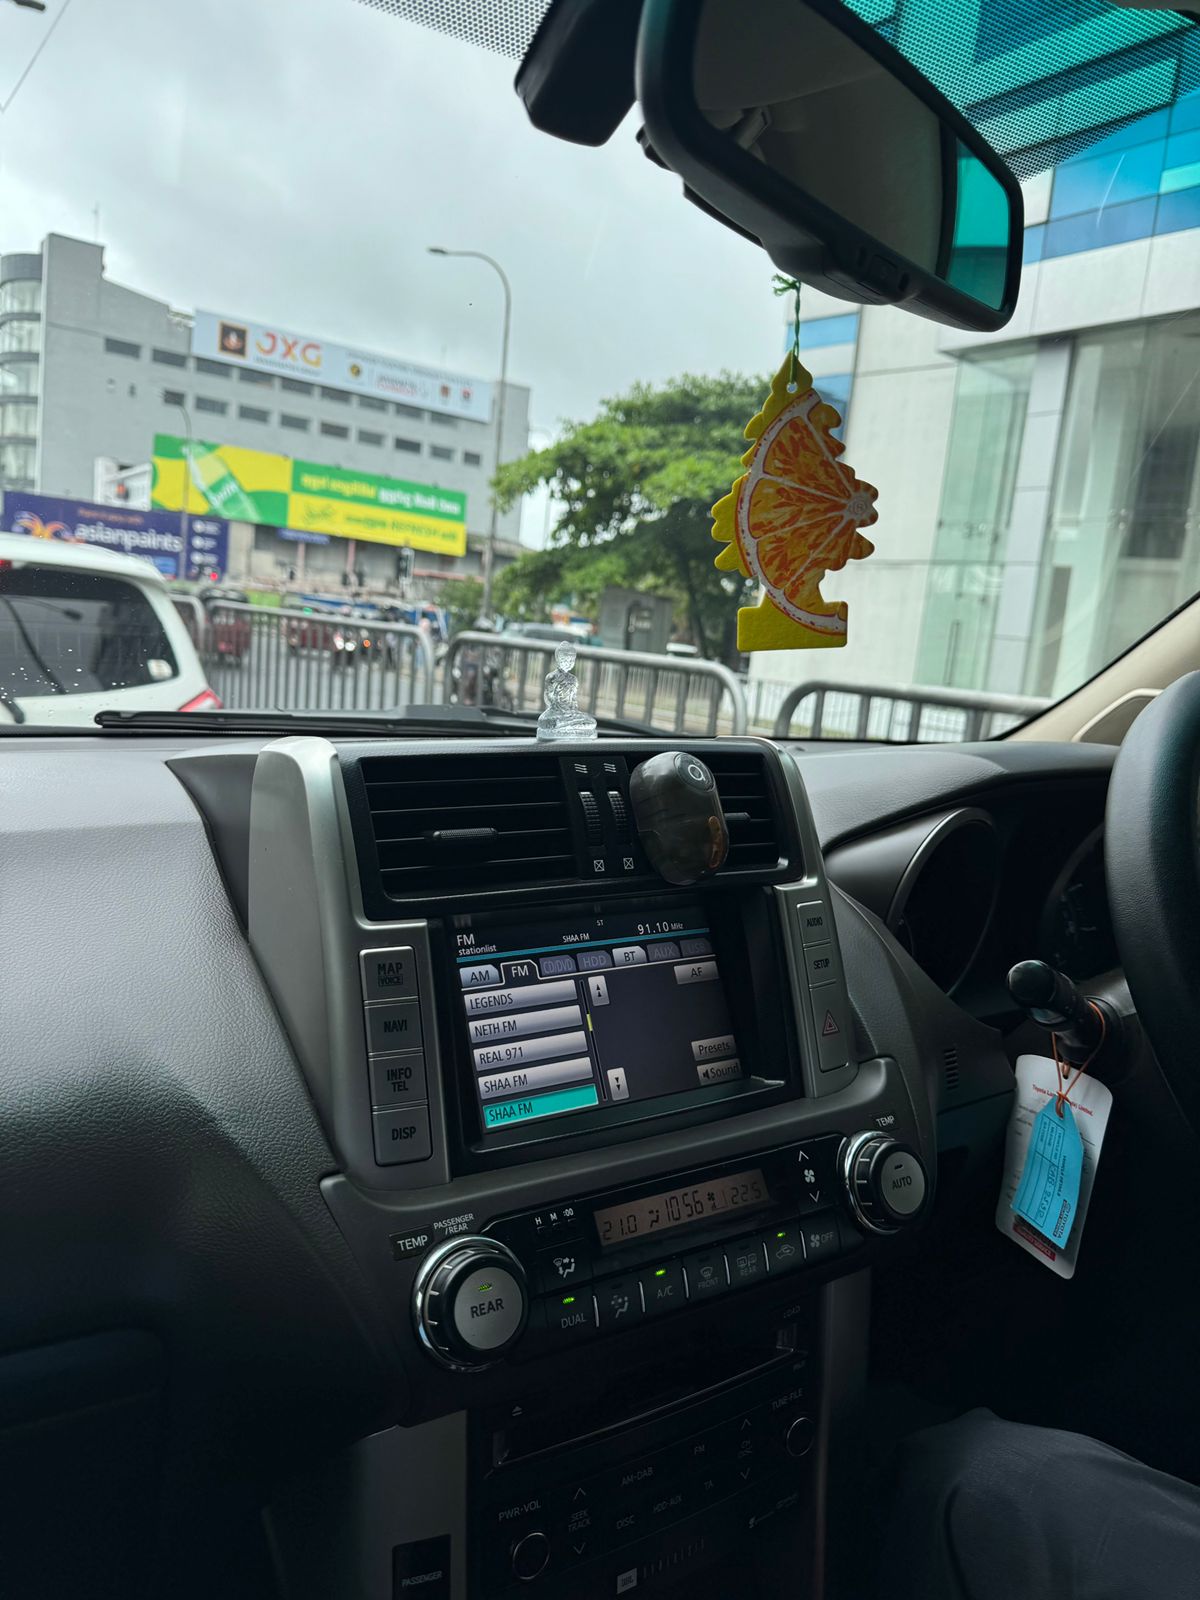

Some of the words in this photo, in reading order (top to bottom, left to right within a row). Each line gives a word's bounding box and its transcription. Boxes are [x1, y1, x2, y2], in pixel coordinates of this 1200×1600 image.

[256, 332, 322, 367] JXG
[75, 522, 183, 553] asianpaints
[637, 922, 669, 935] 91.10
[671, 922, 684, 930] MHz
[806, 916, 823, 927] AUDIO
[456, 933, 475, 945] FM
[562, 934, 578, 943] SHAA
[579, 932, 590, 941] FM
[458, 944, 497, 955] stationlist
[624, 950, 636, 962] BT
[654, 946, 674, 958] AUX
[582, 955, 607, 967] HDD
[814, 958, 830, 970] SETUP
[377, 962, 403, 975] MAP
[470, 969, 490, 982] AM
[511, 965, 529, 977] FM
[691, 967, 703, 978] AF
[380, 975, 401, 985] VOICE
[469, 993, 513, 1009] LEGENDS
[384, 1019, 407, 1033] NAVI
[474, 1022, 500, 1037] NETH
[503, 1020, 517, 1033] FM
[479, 1049, 504, 1063] REAL
[505, 1046, 523, 1059] 971
[698, 1041, 731, 1057] Presets
[387, 1067, 412, 1081] INFO
[710, 1063, 739, 1079] Sound
[392, 1081, 408, 1092] TEL
[484, 1078, 509, 1092] SHAA
[512, 1074, 528, 1086] FM
[489, 1106, 515, 1121] SHAA
[518, 1102, 534, 1115] FM
[875, 1115, 895, 1128] TEMP
[391, 1126, 417, 1141] DISP
[892, 1176, 912, 1189] AUTO
[433, 1213, 474, 1230] PASSENGER
[534, 1216, 542, 1225] H
[549, 1212, 558, 1222] M
[1058, 1210, 1069, 1239] TOYOTA
[397, 1234, 428, 1251] TEMP
[820, 1231, 834, 1243] OFF
[656, 1284, 673, 1299] A/C
[470, 1298, 504, 1318] REAR
[560, 1312, 587, 1328] DUAL
[616, 1514, 635, 1530] DISC
[401, 1570, 443, 1588] PASSENGER
